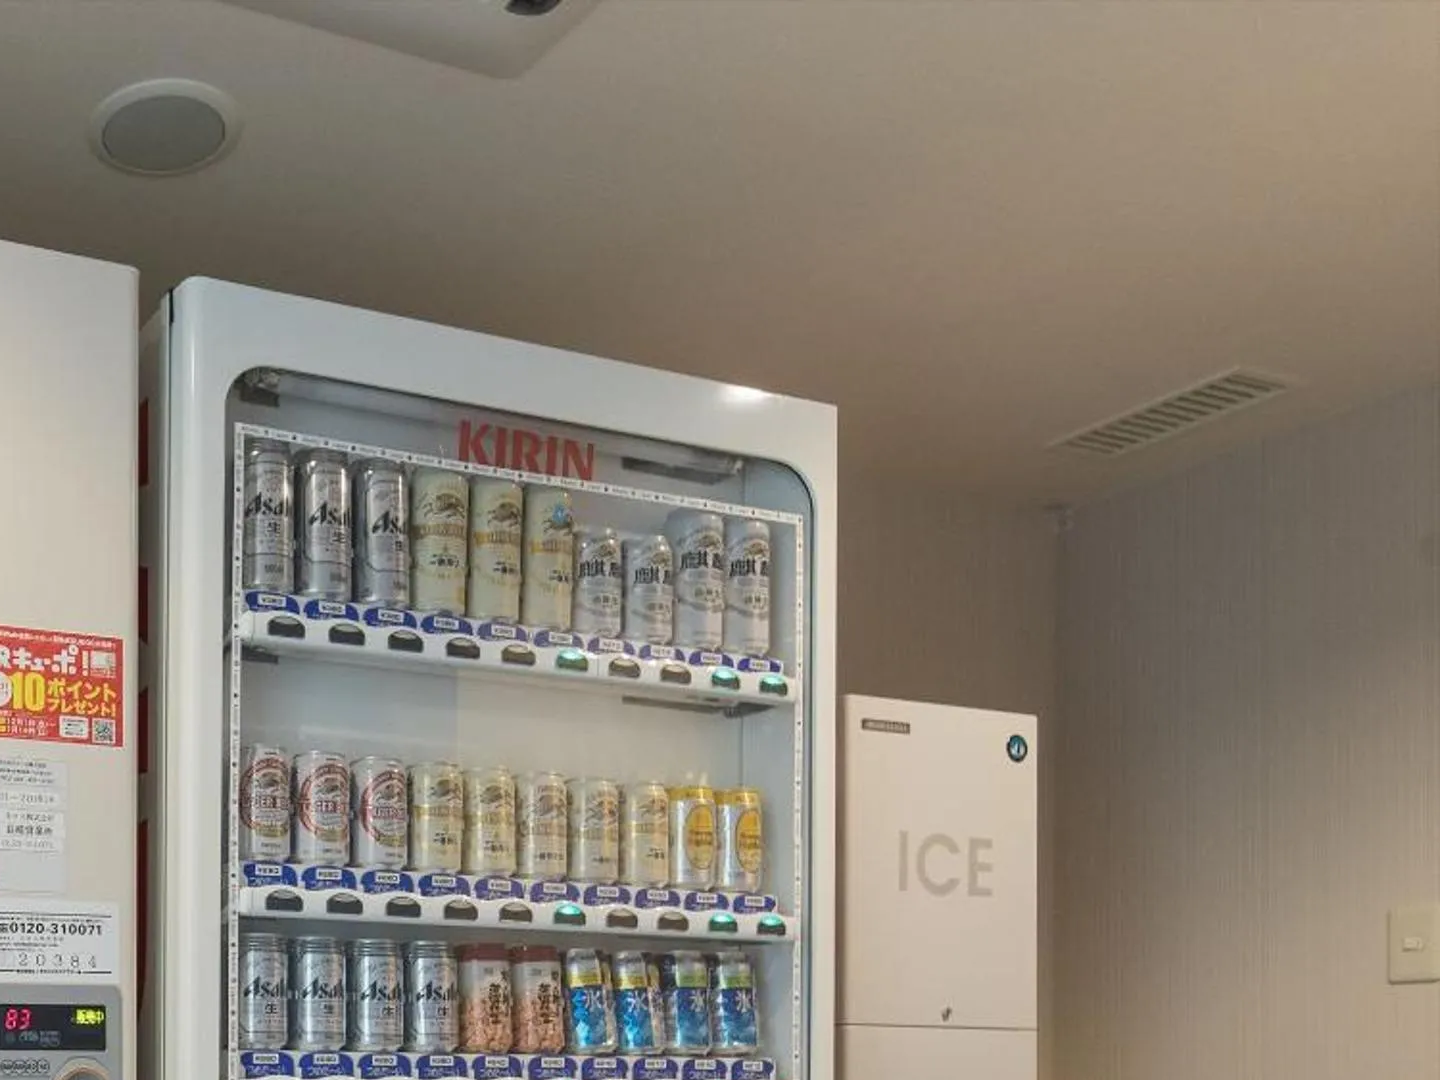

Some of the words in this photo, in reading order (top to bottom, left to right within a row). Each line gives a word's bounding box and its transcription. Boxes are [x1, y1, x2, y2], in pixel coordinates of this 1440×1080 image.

[457, 419, 595, 482] KIRIN
[10, 671, 45, 712] 10
[47, 678, 116, 702] ポイント
[47, 698, 116, 717] プレゼント!
[898, 830, 993, 897] ICE
